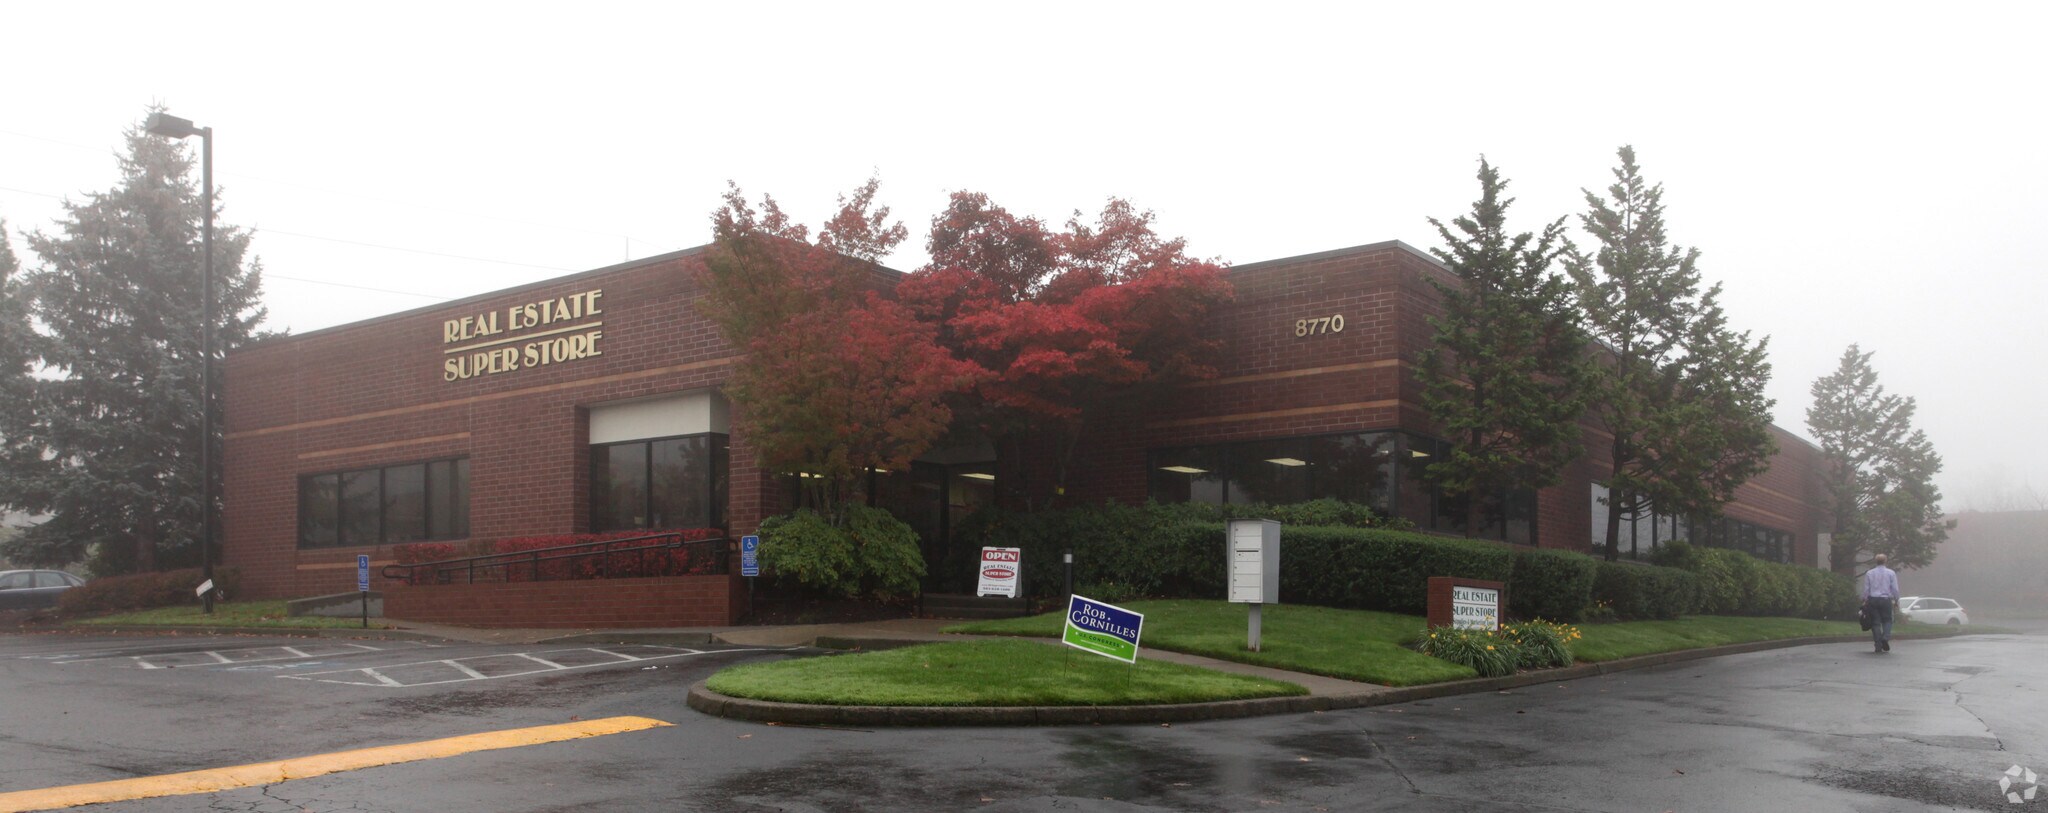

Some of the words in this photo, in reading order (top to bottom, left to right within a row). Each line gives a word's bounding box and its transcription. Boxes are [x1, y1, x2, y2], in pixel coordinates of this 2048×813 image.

[444, 311, 503, 343] REAL
[509, 289, 603, 331] ESTATE
[1295, 314, 1345, 337] 8770
[444, 347, 520, 382] SUPER
[523, 330, 603, 368] STORE
[985, 551, 1016, 561] OPEN
[1453, 590, 1470, 601] REAL
[1471, 591, 1497, 603] ESTATE
[1475, 606, 1496, 617] STORE
[1088, 635, 1120, 648] CONGRESS
